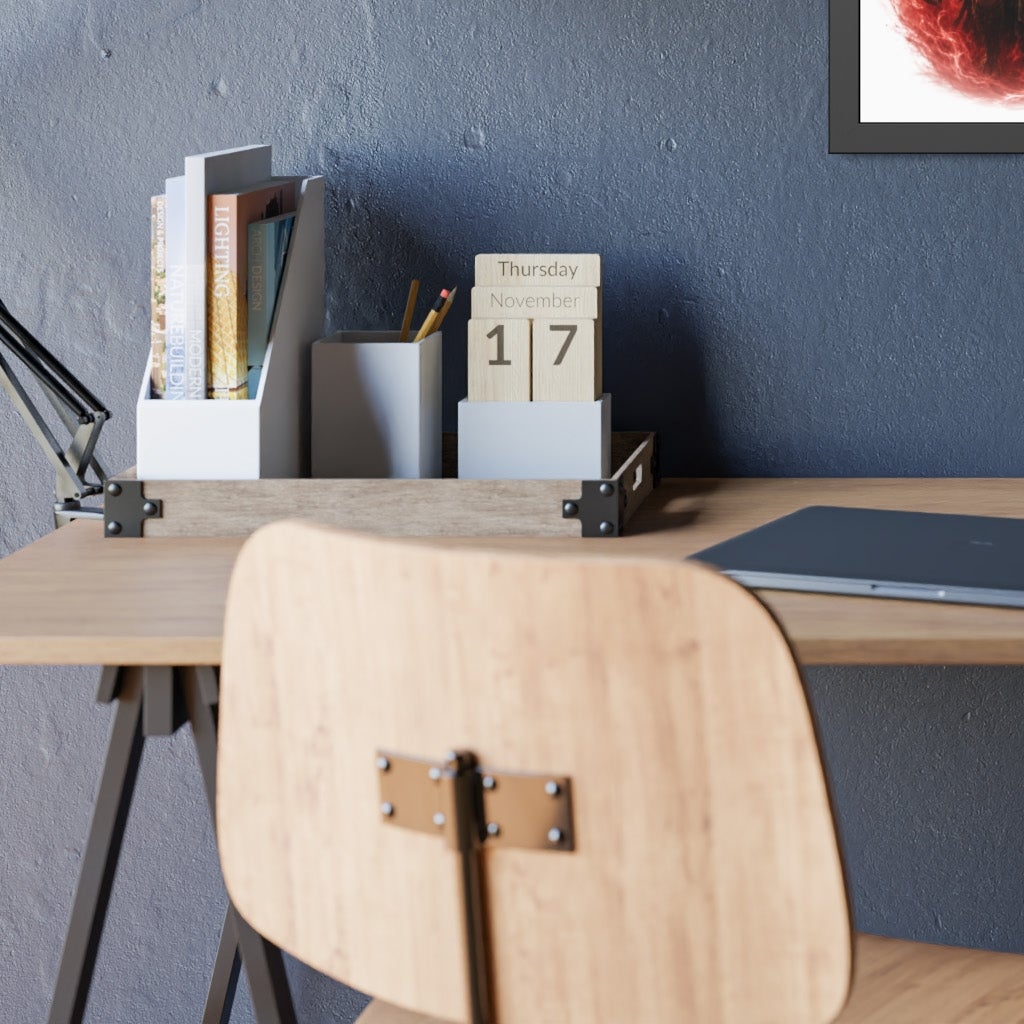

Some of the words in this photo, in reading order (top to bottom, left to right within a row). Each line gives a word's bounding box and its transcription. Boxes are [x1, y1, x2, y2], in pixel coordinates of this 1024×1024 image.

[214, 206, 230, 298] LIGHTING
[497, 260, 579, 280] Thursday
[251, 265, 263, 311] DESIGN
[490, 292, 580, 309] November
[188, 329, 203, 400] MODERN
